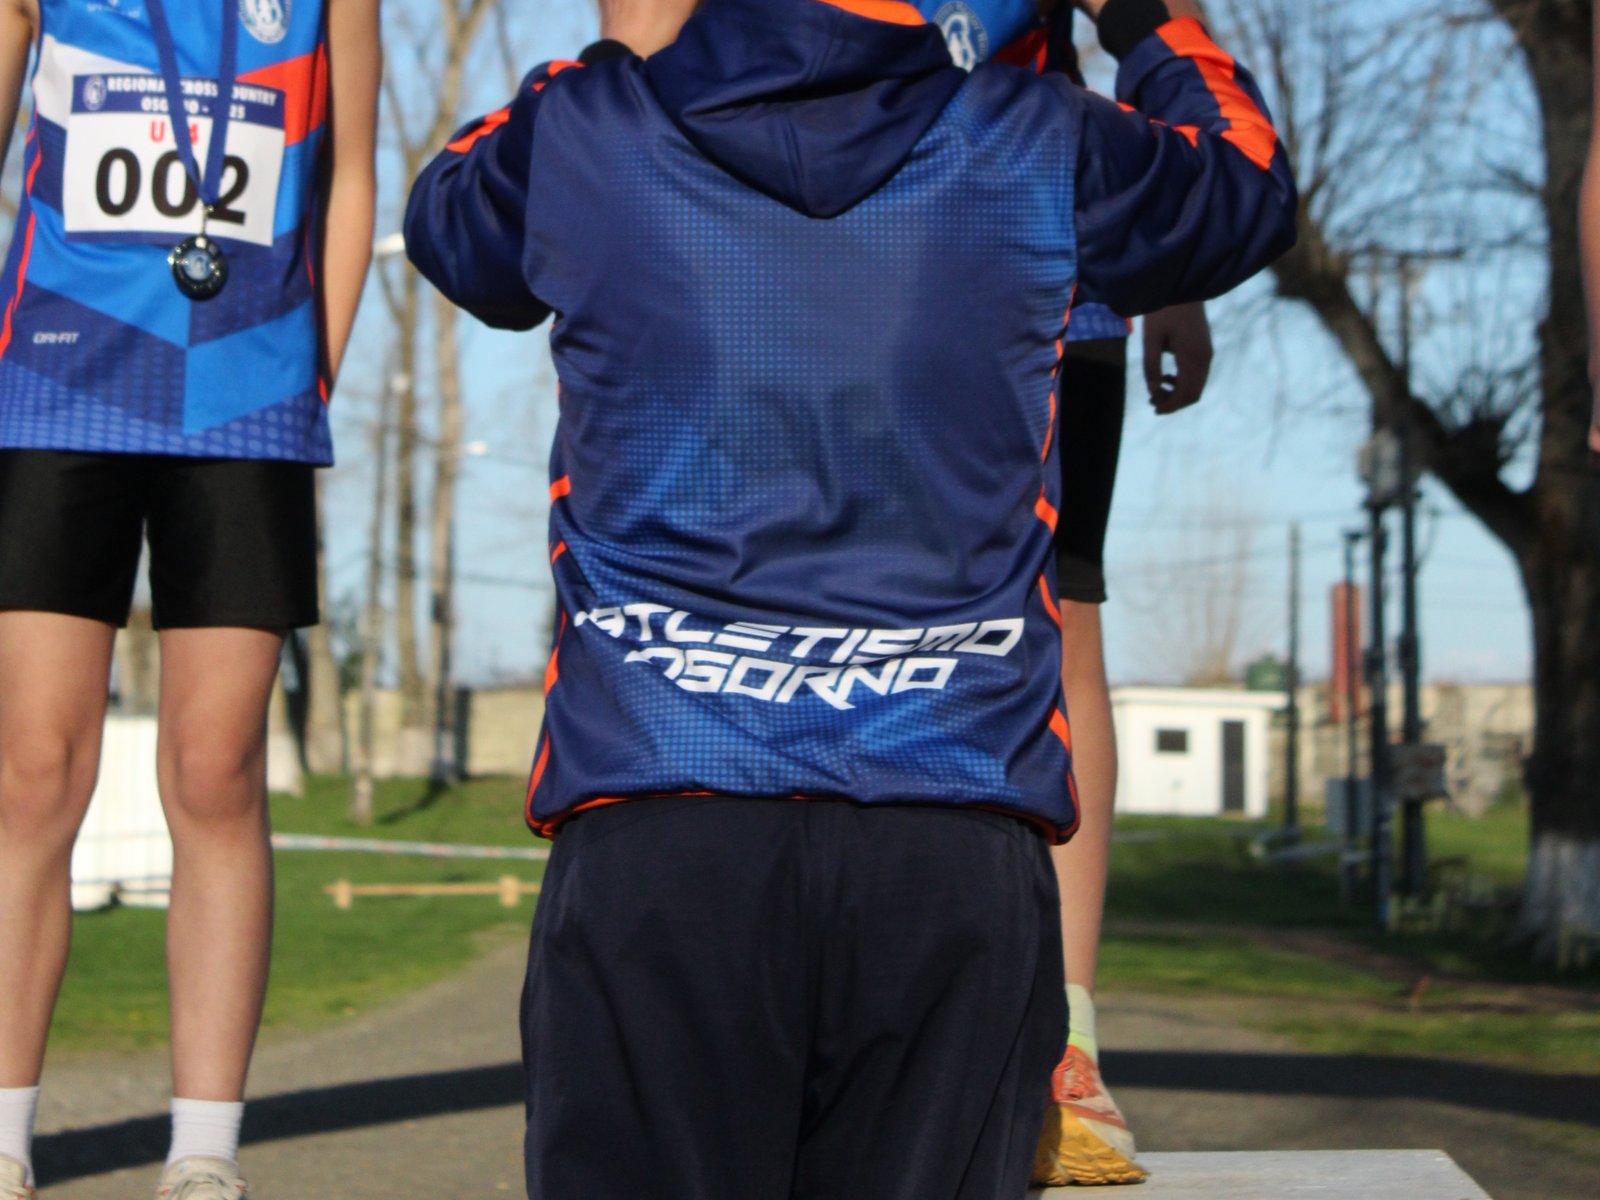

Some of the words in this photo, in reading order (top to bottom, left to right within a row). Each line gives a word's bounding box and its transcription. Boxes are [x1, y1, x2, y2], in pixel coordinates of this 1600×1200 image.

[107, 77, 166, 93] REGIONA
[232, 85, 277, 106] OUNTRY
[96, 147, 249, 225] 002
[573, 602, 1026, 662] ATLETISMO
